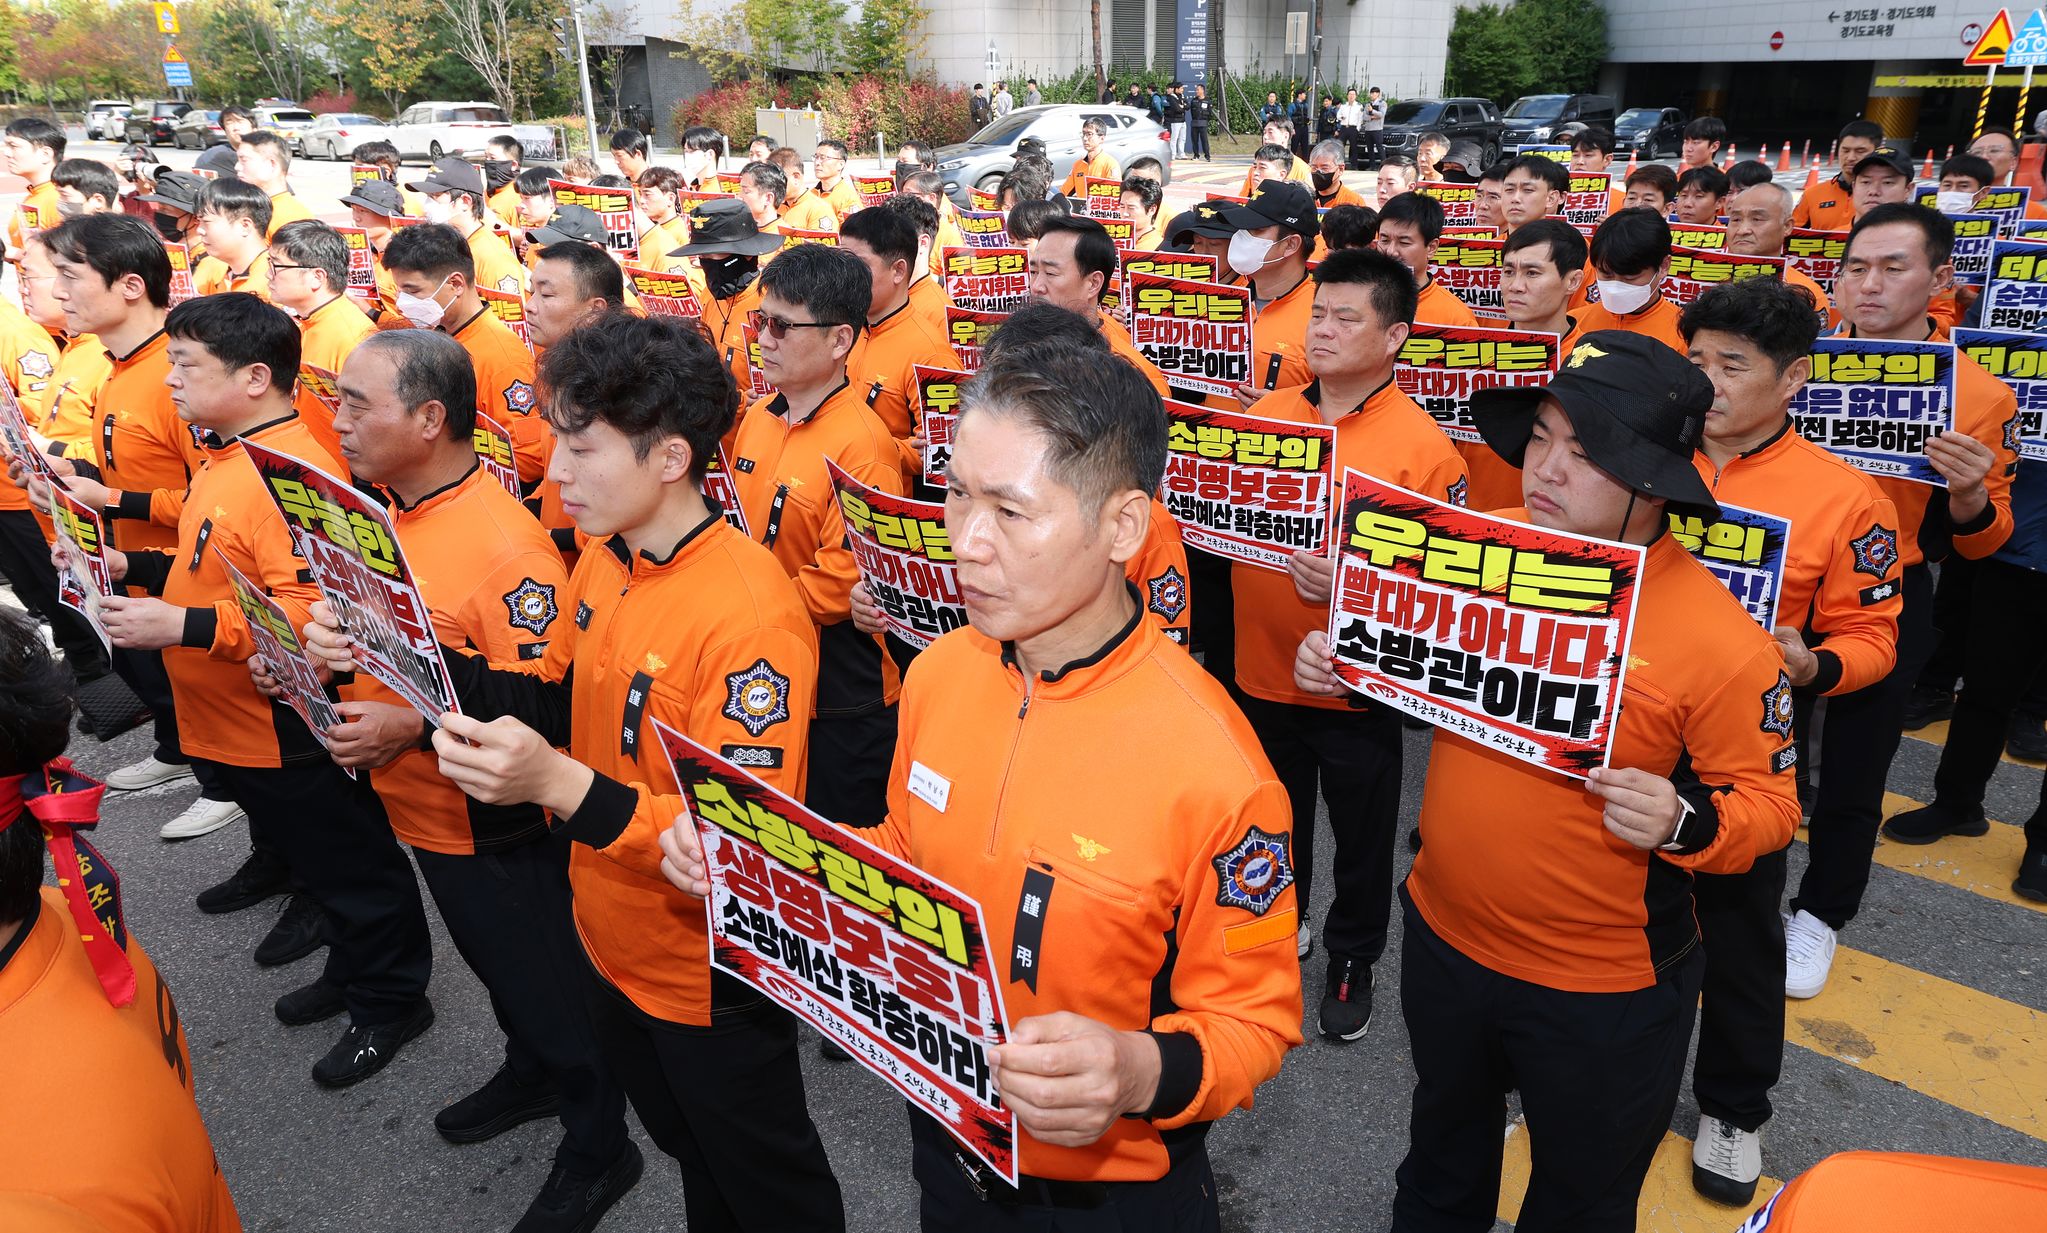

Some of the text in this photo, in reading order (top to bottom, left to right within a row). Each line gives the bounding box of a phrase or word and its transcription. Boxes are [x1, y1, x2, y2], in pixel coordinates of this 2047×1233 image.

[1843, 6, 1936, 22] 경기도청 경기도의회
[1840, 25, 1894, 38] 경기도교육청
[721, 181, 741, 194] 무능
[971, 194, 998, 210] 무능
[1565, 193, 1605, 210] 보호!
[1570, 178, 1607, 192] 관의
[949, 254, 1025, 276] 무능한
[1433, 268, 1503, 289] 소방지휘
[1954, 257, 1987, 272] 하라!
[1998, 256, 2036, 281] 더
[634, 277, 689, 298] 우리는
[953, 277, 1027, 297] 소방지휘부
[1996, 284, 2047, 309] 순직
[1138, 289, 1244, 321] 우리는
[1137, 317, 1247, 352] 빨대가 아니다
[1140, 345, 1248, 382] 소방관이다
[1398, 338, 1548, 371] 우리는
[1396, 368, 1470, 398] 빨대가
[1848, 387, 1942, 422] 없다!
[473, 428, 512, 466] 리는
[1168, 420, 1322, 471] 소방관의
[1167, 456, 1322, 515] 생명보호!
[270, 476, 402, 577] 무능한
[840, 489, 958, 561] 우리는
[1168, 491, 1324, 550] 소방예산 확충하라!
[1350, 511, 1614, 614] 우리는
[907, 560, 966, 607] 아니
[527, 600, 541, 611] 119
[1340, 564, 1611, 681] 빨대가 아니다
[1336, 618, 1602, 741] 소방관이다
[750, 692, 770, 702] 119
[1401, 696, 1537, 758] 전국공무원노동조합 소방본부
[694, 777, 969, 966] 소방관의
[716, 834, 985, 1038] 생명보호!
[724, 894, 845, 998] 소방예산
[805, 998, 950, 1114] 전국공무원노동조합 소방본부
